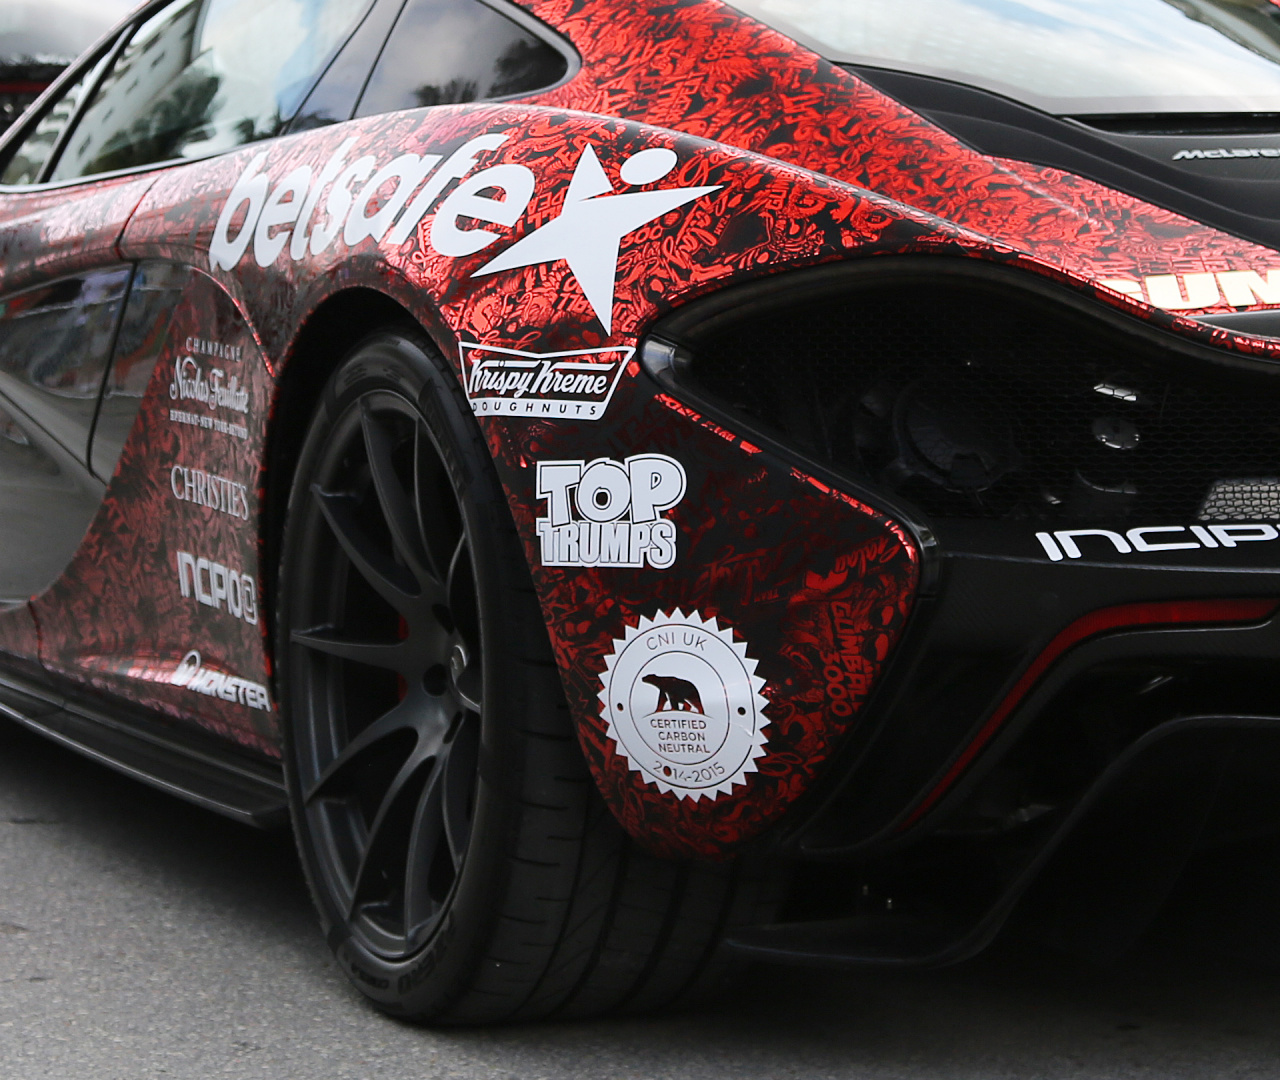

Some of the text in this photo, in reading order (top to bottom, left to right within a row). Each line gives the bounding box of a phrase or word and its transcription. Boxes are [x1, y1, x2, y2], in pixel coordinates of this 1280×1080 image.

[209, 133, 535, 272] betsafe
[186, 336, 242, 362] CHAMPAGNE
[470, 360, 615, 398] Krispy Kreme
[471, 401, 597, 416] DOUGHNUTS
[536, 453, 687, 527] TOP
[536, 518, 677, 570] TRUMPS
[646, 632, 708, 651] CNI UK
[186, 667, 271, 713] MONSTER
[650, 718, 706, 730] CERTIFIED
[658, 731, 706, 741] CARBON
[658, 743, 710, 754] NEUTRAL
